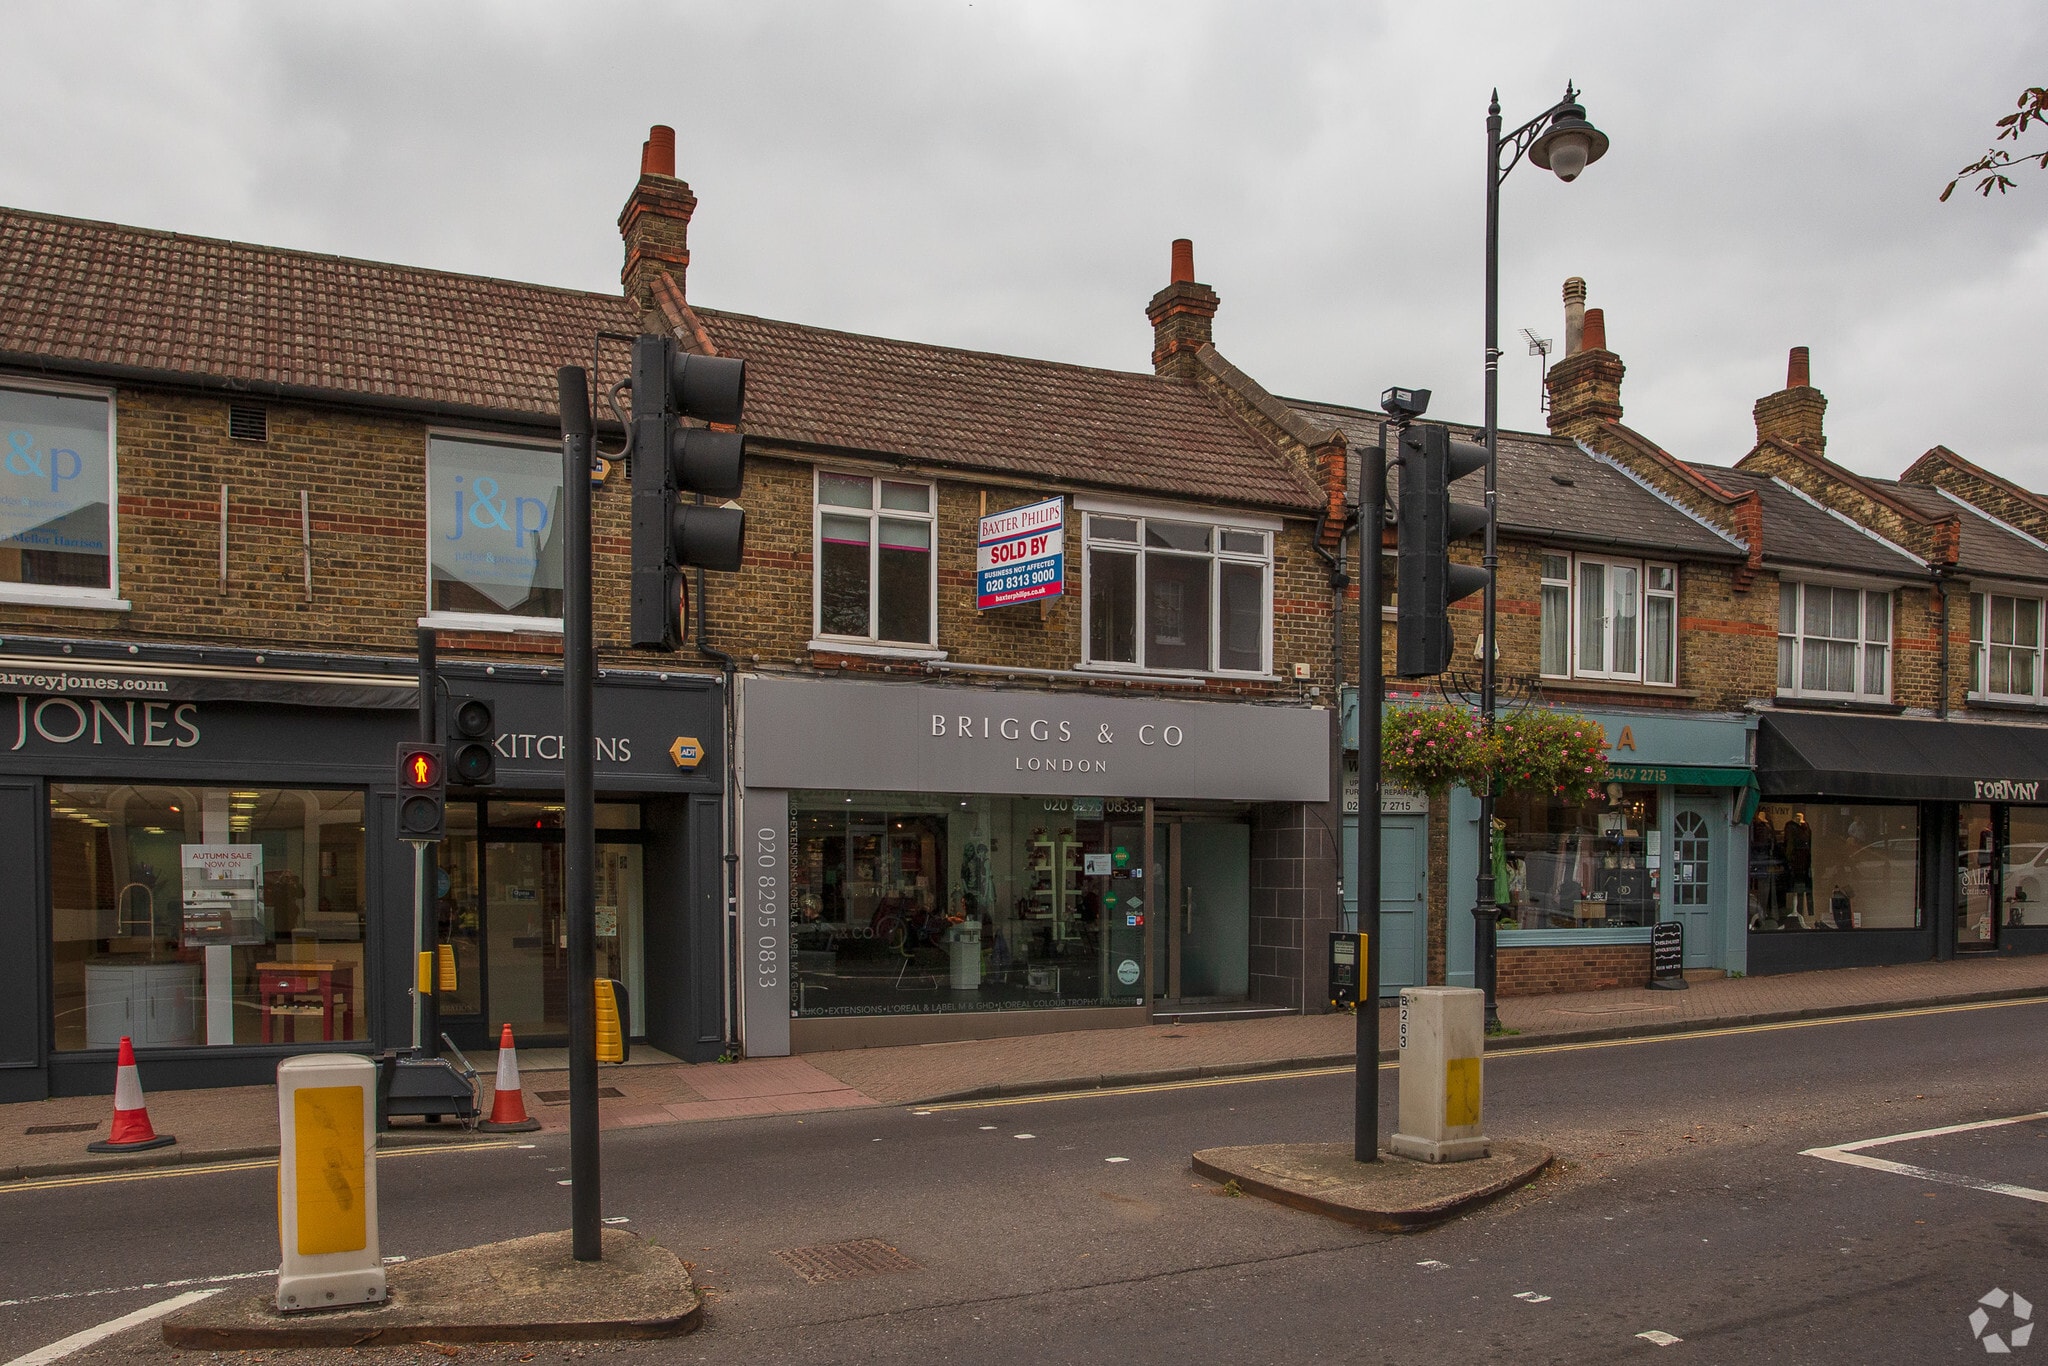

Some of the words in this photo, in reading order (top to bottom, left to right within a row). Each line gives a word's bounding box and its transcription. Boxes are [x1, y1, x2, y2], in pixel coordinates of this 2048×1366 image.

[445, 475, 548, 549] j&p
[982, 516, 1018, 537] BAXTER
[1021, 505, 1060, 528] PHILIPS
[14, 532, 50, 545] Mellor
[54, 536, 103, 549] Harrison
[991, 541, 1027, 564] SOLD
[1030, 535, 1048, 556] BY
[984, 568, 1013, 579] BUSINESS
[1013, 564, 1026, 574] NOT
[1026, 559, 1055, 571] AFFECTED
[986, 577, 1004, 593] 020
[1006, 573, 1030, 589] 8313
[1032, 568, 1055, 584] 9000
[995, 587, 1046, 602] baxterphilips.co.uk
[11, 696, 200, 750] JONES
[931, 714, 1072, 742] BRIGGS
[1097, 723, 1114, 743] &
[1138, 724, 1183, 747] CO
[681, 749, 697, 757] ADT
[1015, 757, 1107, 773] LONDON
[1640, 769, 1667, 781] 2715
[1043, 799, 1068, 811] 020
[1106, 801, 1138, 813] 0833
[1389, 801, 1411, 811] 2715
[758, 828, 776, 868] 020
[790, 821, 798, 878] EXTENSIONS
[1961, 868, 1990, 886] SALE
[758, 875, 777, 928] 8295
[852, 926, 874, 940] CO
[790, 932, 798, 959] LABEL
[758, 936, 777, 988] 0833
[790, 961, 798, 970] M
[790, 972, 798, 980] &
[790, 981, 799, 1002] GHD
[828, 1004, 883, 1015] EXTENSIONS
[923, 1003, 930, 1012] &
[931, 1002, 957, 1012] LABEL
[976, 1001, 994, 1010] GHD
[1033, 998, 1066, 1008] COLOUR
[1068, 998, 1098, 1007] TROPHY
